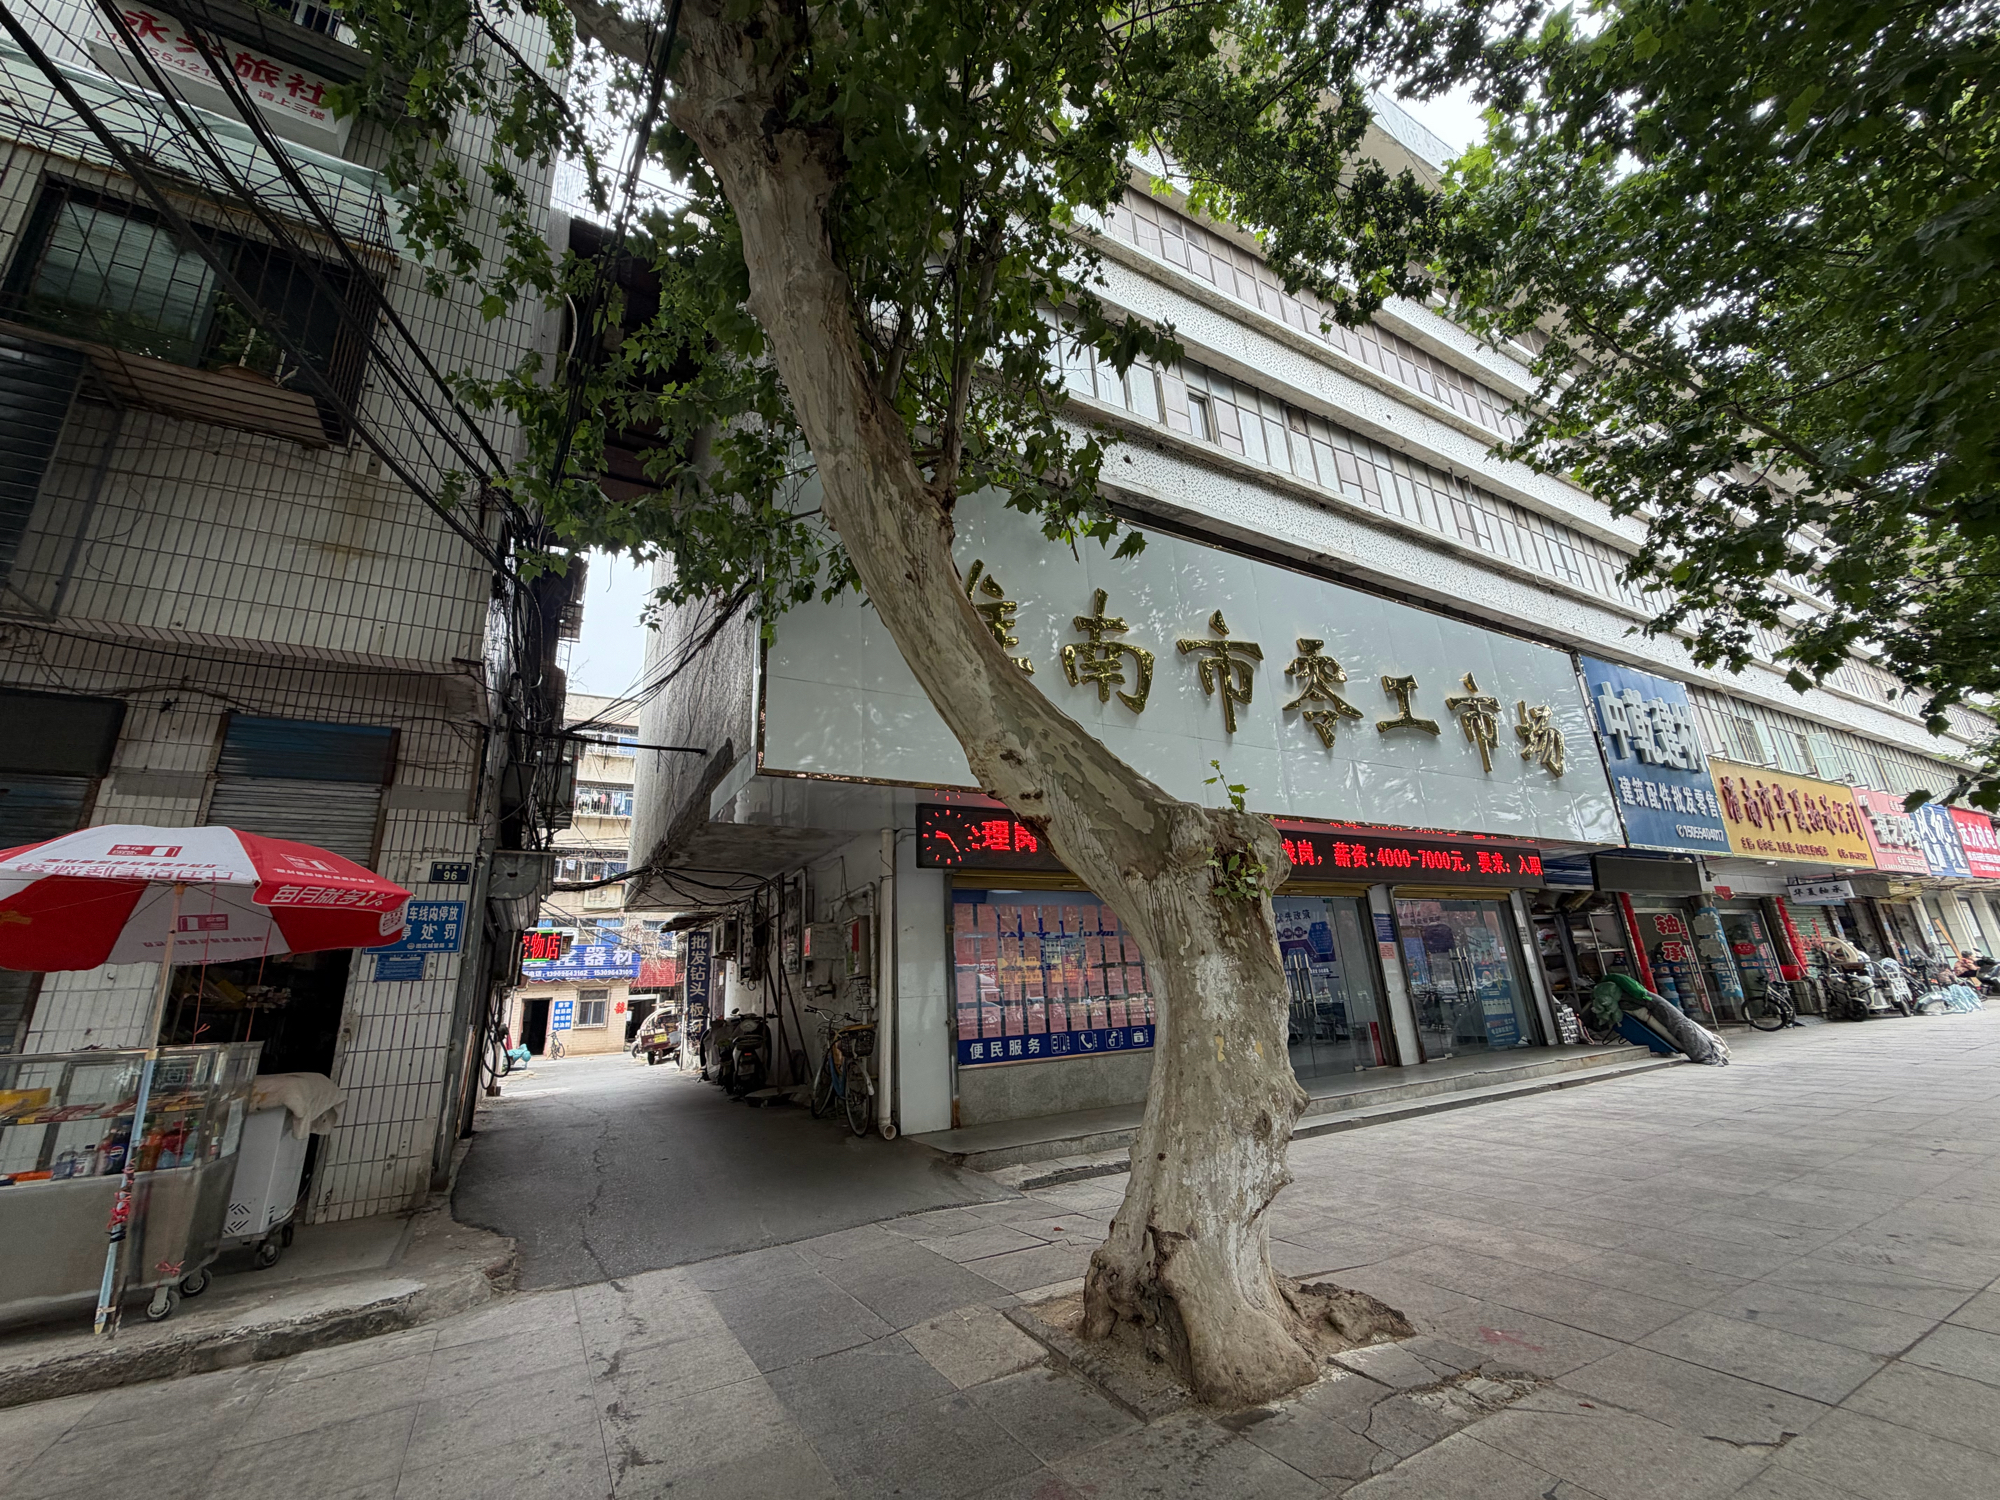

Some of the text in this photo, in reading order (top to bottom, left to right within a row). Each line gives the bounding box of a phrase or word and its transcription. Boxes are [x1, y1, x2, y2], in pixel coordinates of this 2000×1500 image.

[258, 88, 326, 122] 请上三楼
[1597, 681, 1707, 773] 中乾建材
[1618, 775, 1719, 819] 建筑配件批发零售
[443, 870, 458, 881] 96
[270, 884, 395, 907] 每月就多1%
[1793, 885, 1844, 896] 华夏轴承
[408, 905, 459, 921] 车线内停放
[1653, 913, 1688, 962] 轴承
[690, 935, 708, 997] 批发钻头
[969, 1038, 1041, 1060] 便民服务
